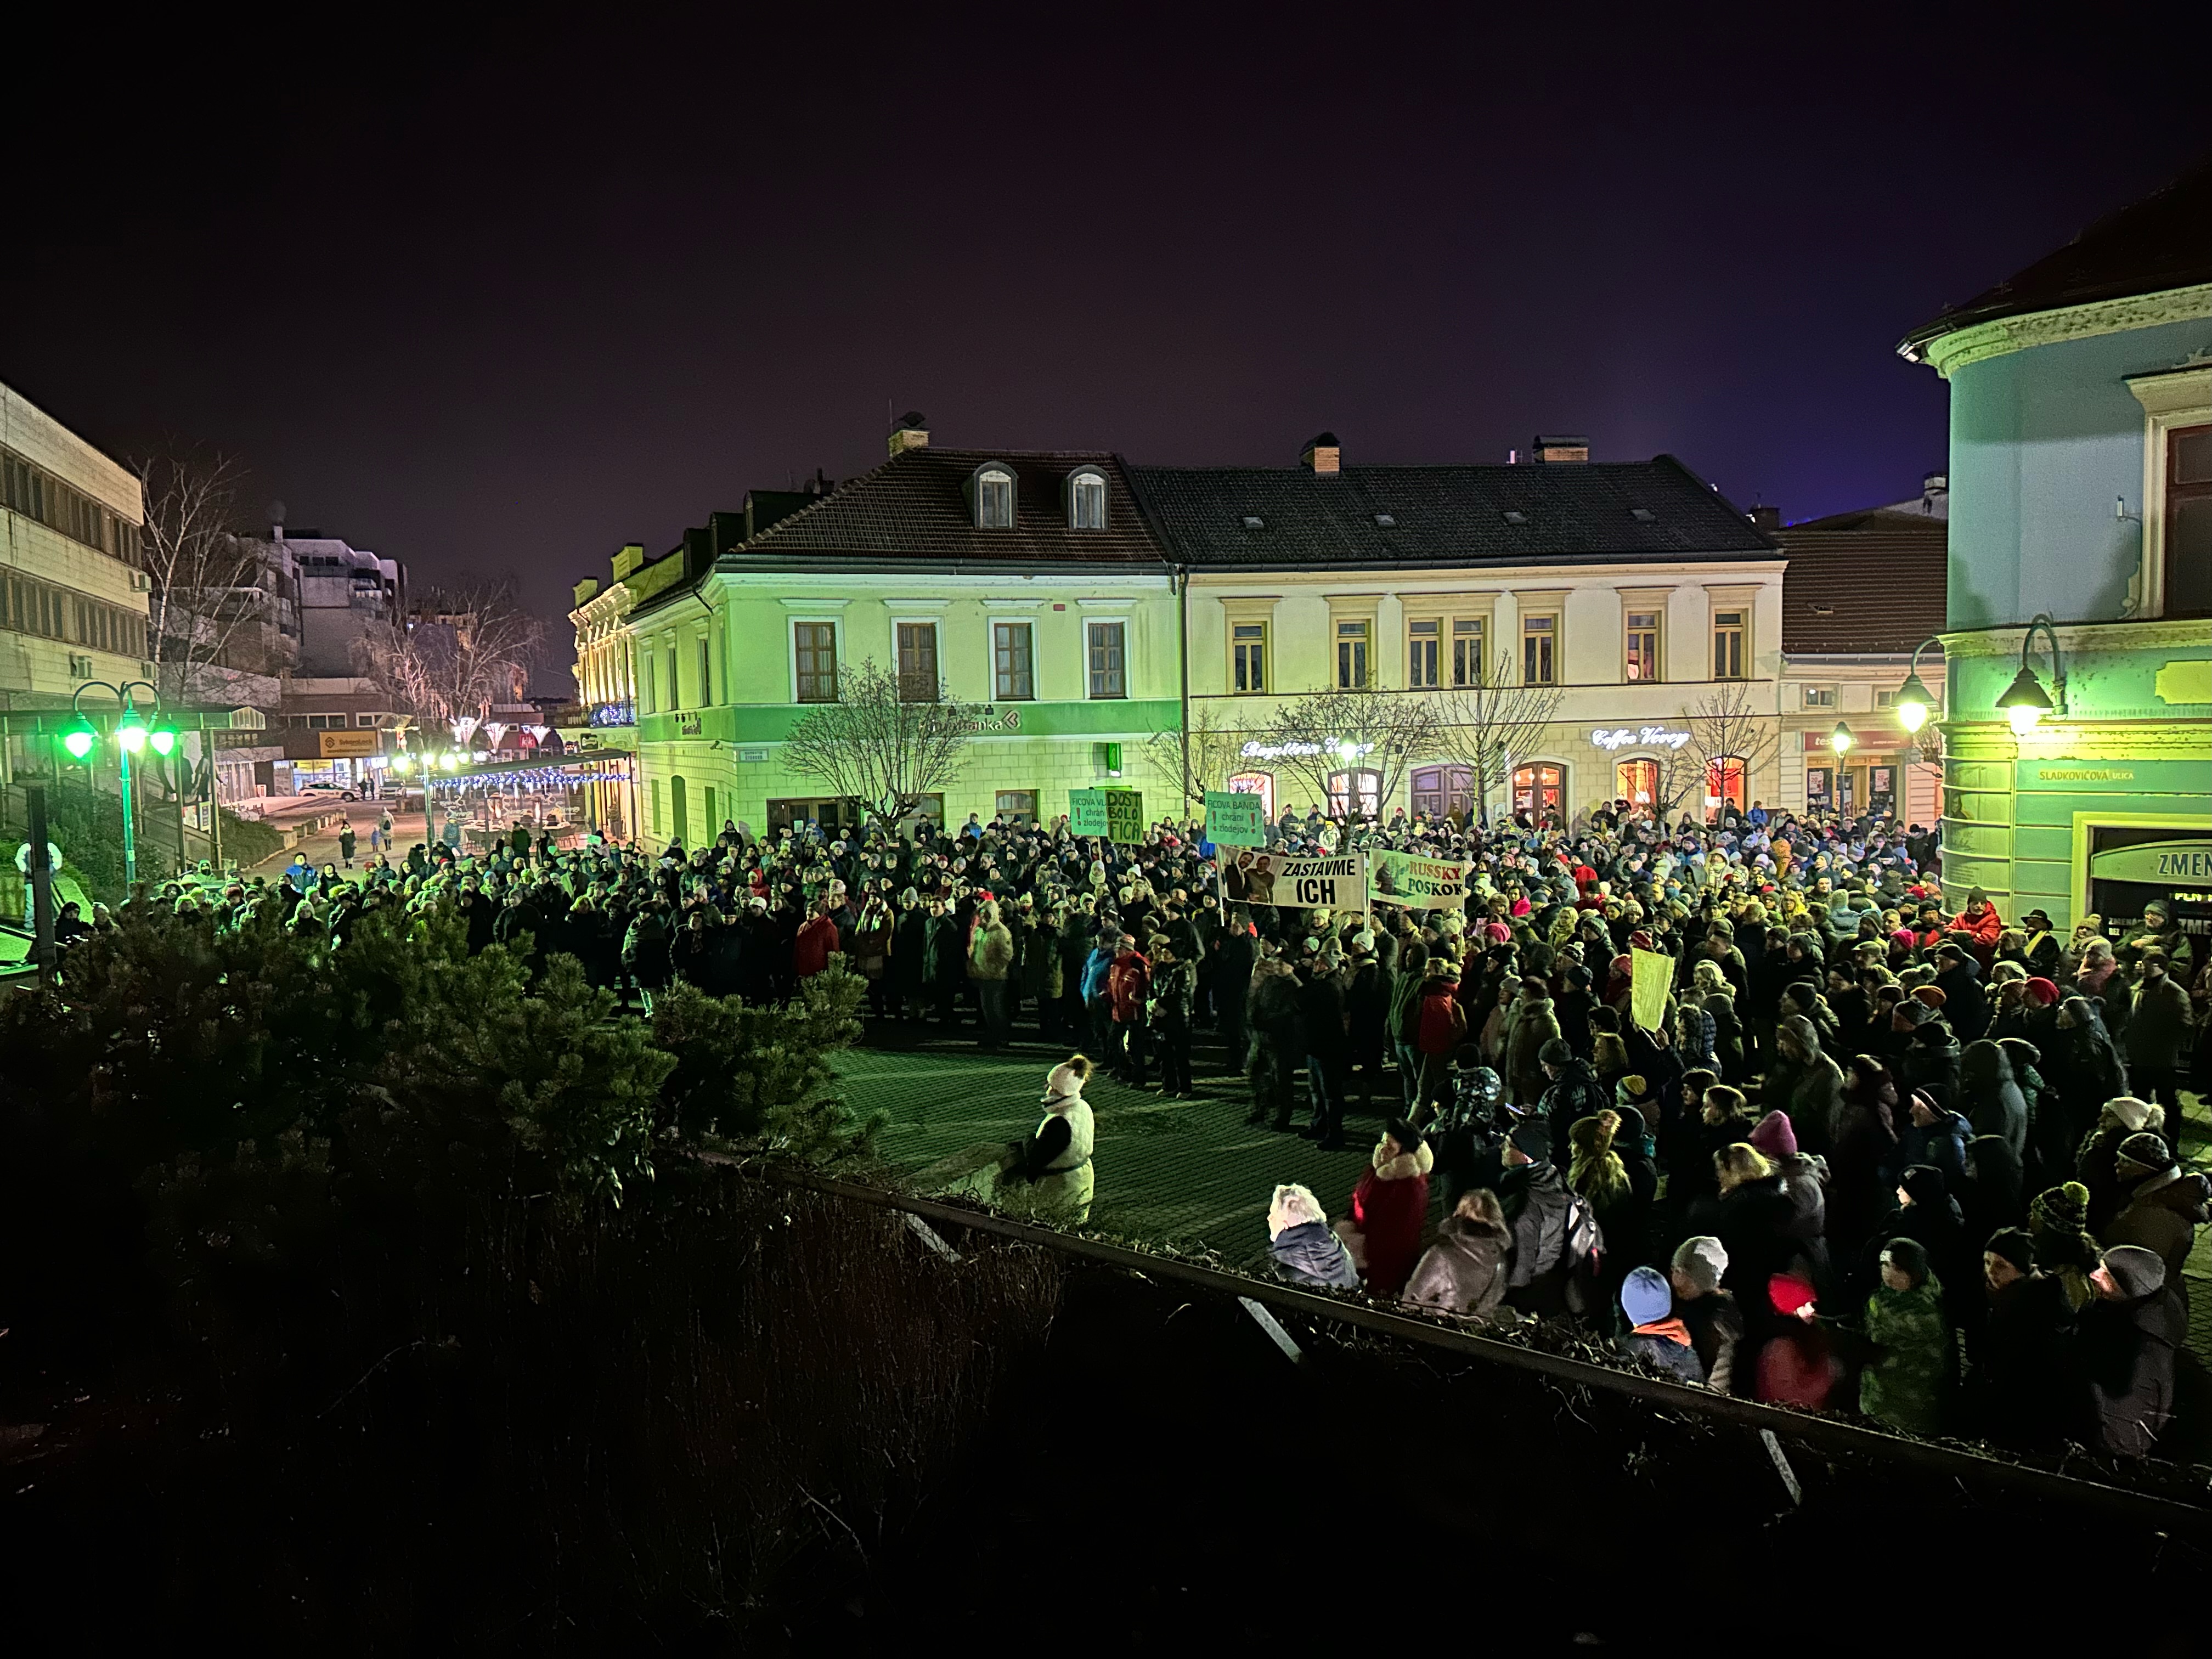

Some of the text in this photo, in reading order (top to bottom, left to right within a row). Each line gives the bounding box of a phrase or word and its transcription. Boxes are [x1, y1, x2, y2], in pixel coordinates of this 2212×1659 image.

[1592, 729, 1637, 750] Coffee
[1815, 737, 1860, 746] tesa.
[2039, 770, 2108, 781] SLADKOVIČOVA
[1072, 798, 1095, 806] FICOVA
[1106, 792, 1142, 808] DOST
[1207, 800, 1261, 810] FICOVA BANDA
[1108, 806, 1138, 820] BOLO
[1109, 821, 1141, 841] FICA
[1219, 823, 1249, 835] zlodejov
[1282, 859, 1356, 877] ZASTAVME
[1296, 879, 1335, 905] ICH
